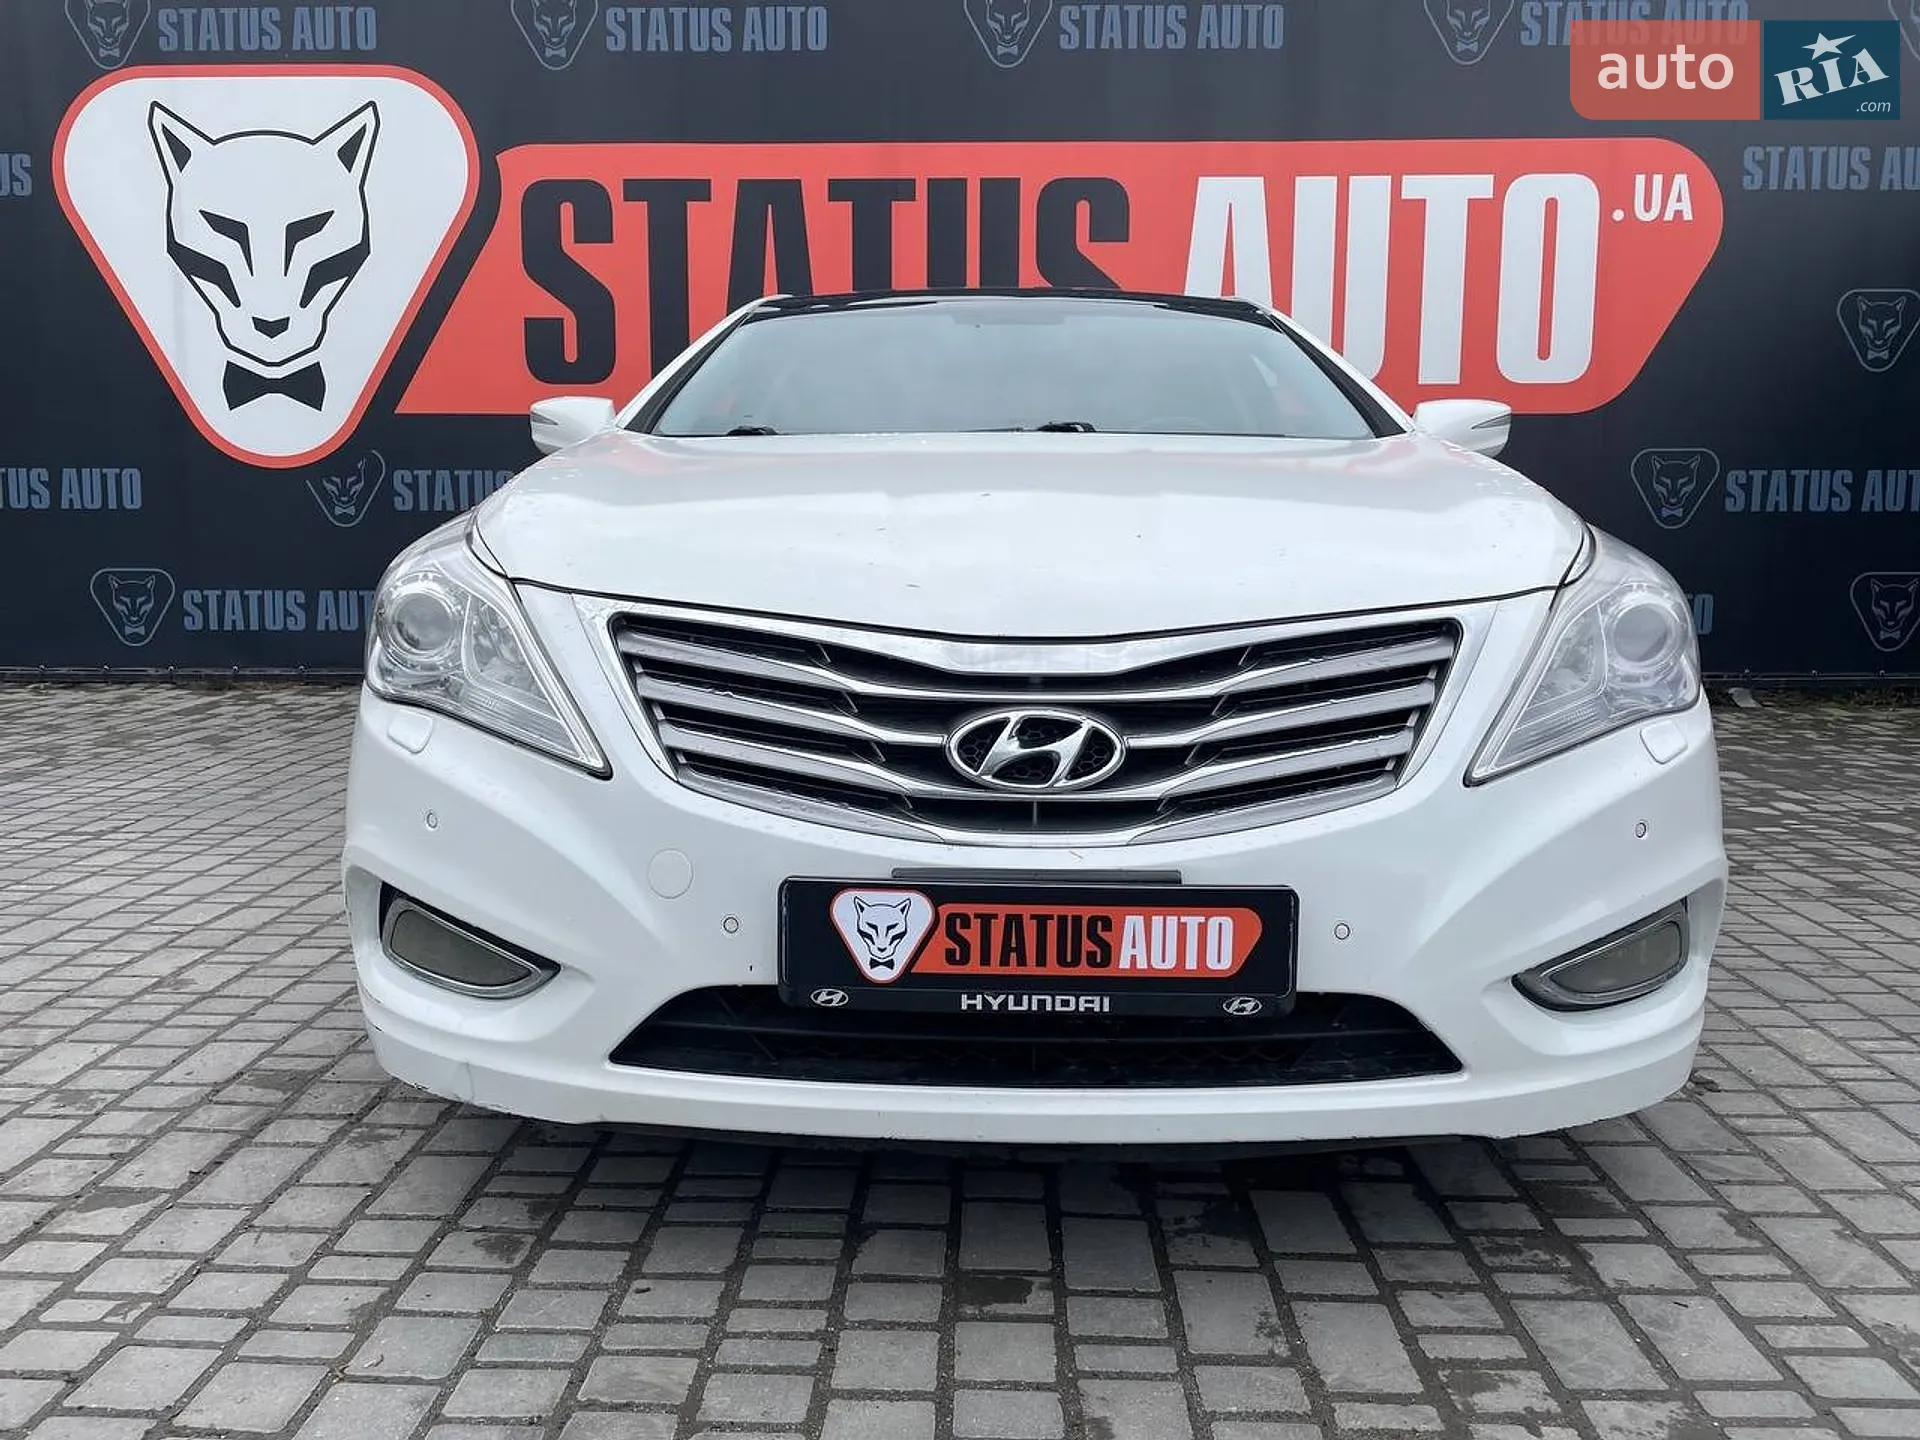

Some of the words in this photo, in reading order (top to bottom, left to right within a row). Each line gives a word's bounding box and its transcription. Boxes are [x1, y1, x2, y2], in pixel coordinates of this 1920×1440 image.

[158, 7, 281, 52] STATUS
[292, 6, 378, 52] AUTO
[605, 6, 732, 52] STATUS
[742, 6, 828, 52] AUTO
[1059, 5, 1187, 50] STATUS
[1197, 3, 1285, 49] AUTO
[1742, 146, 1871, 191] STATUS
[1183, 173, 1600, 385] AUTO
[61, 467, 142, 510] AUTO
[1725, 469, 1852, 513] STATUS
[183, 589, 306, 631] STATUS
[944, 911, 1112, 969] STATUS
[1118, 915, 1235, 970] AUTO
[960, 993, 1110, 1013] HYUNDAI
